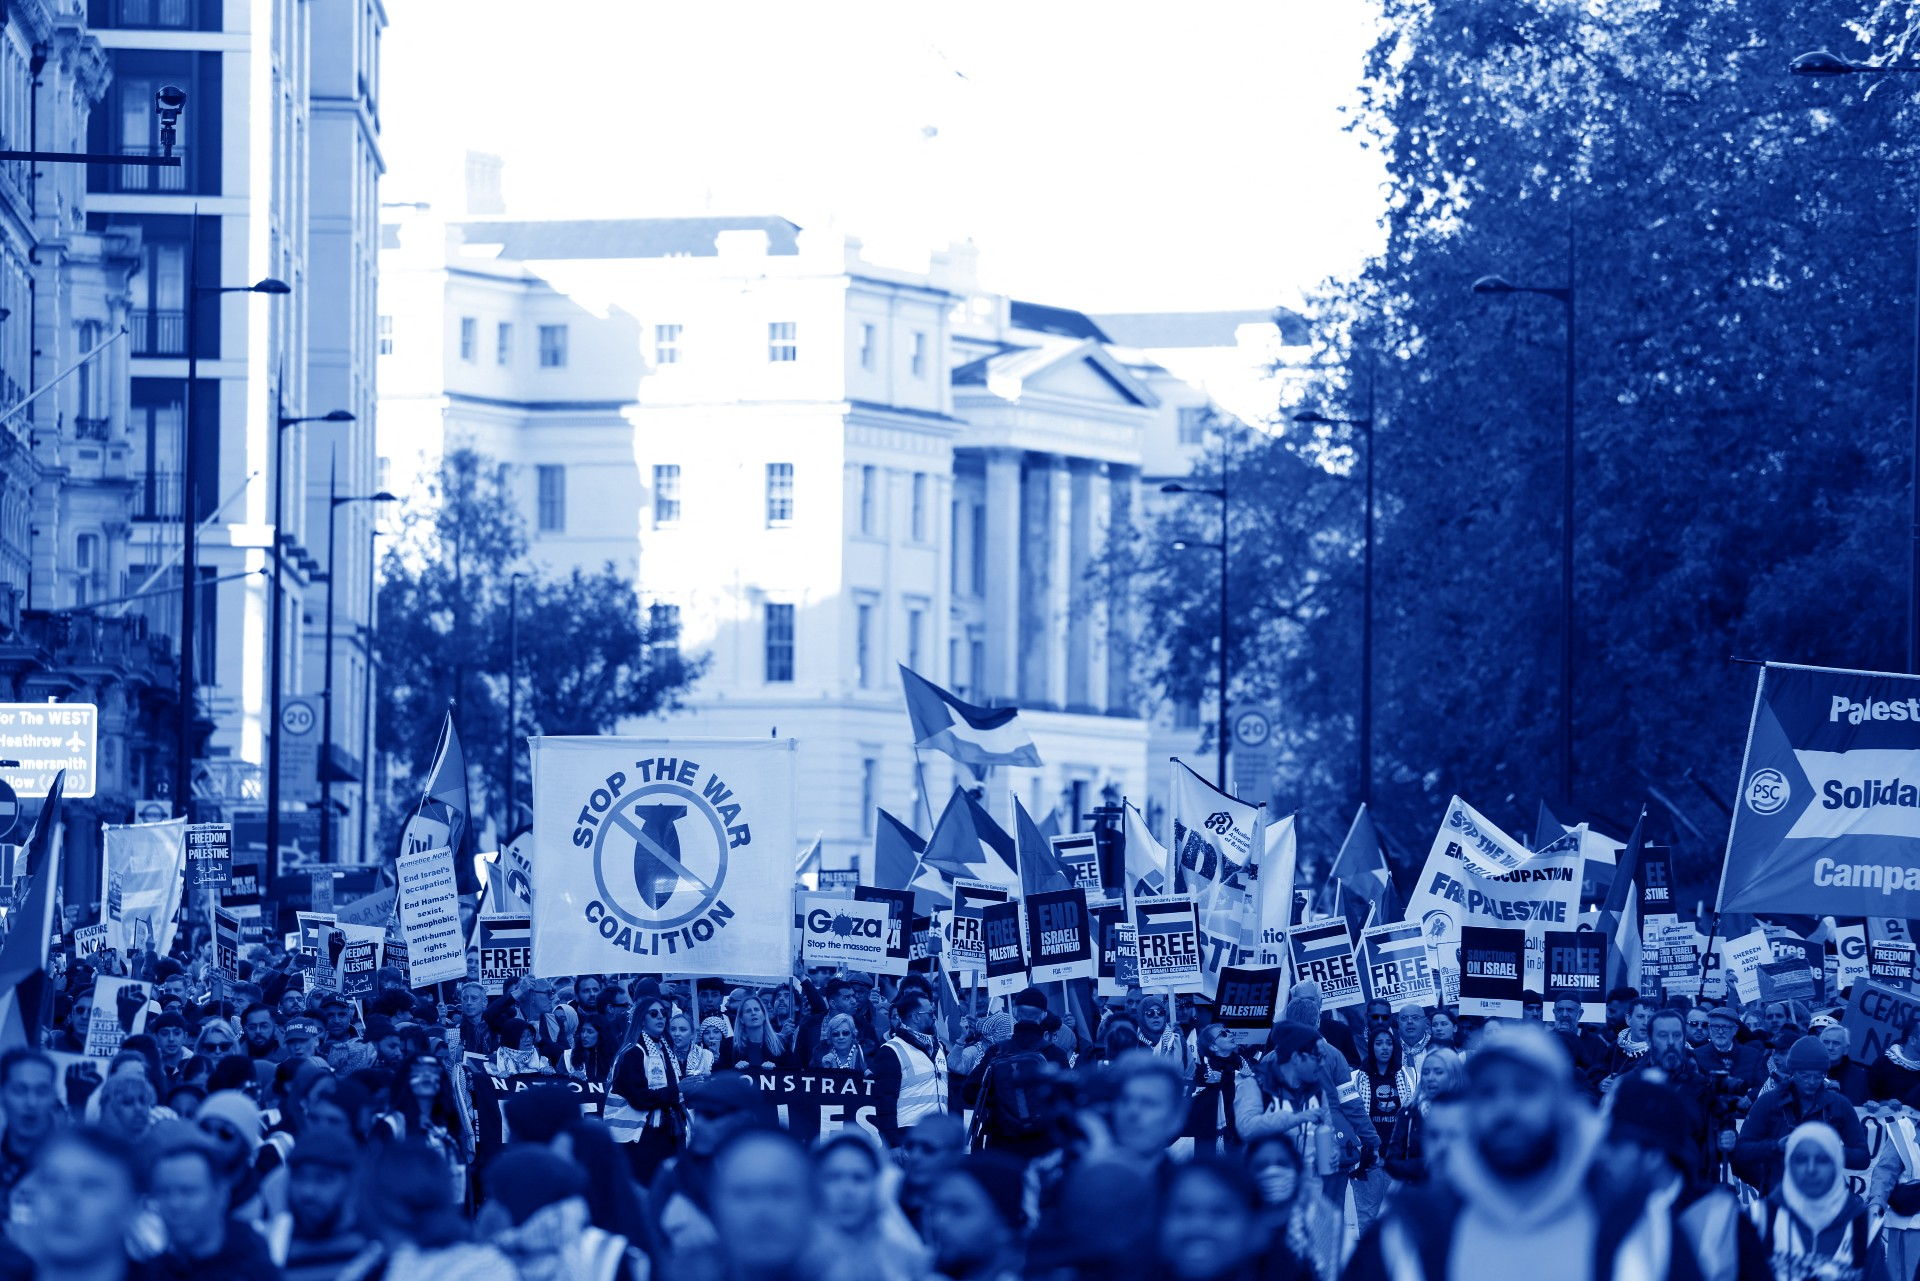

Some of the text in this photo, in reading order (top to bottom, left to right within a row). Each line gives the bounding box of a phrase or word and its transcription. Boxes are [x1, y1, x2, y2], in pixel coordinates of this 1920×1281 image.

[0, 712, 91, 725] or The WEST
[286, 712, 310, 726] 20
[1242, 722, 1264, 736] 20
[0, 757, 87, 770] mersmith
[39, 774, 86, 791] (A0)
[158, 783, 168, 793] 12
[1752, 784, 1781, 801] PSC
[573, 757, 752, 849] STOP THE WAR
[189, 832, 227, 844] FREEDOM
[188, 847, 230, 860] PALESTINE
[1476, 834, 1505, 860] THE
[404, 866, 450, 883] End Israel's
[1075, 862, 1098, 880] EE
[1644, 861, 1667, 886] EE
[1076, 879, 1099, 889] STINE
[1429, 872, 1467, 908] FR
[1645, 887, 1669, 900] STINE
[404, 893, 455, 910] End Hamas's
[417, 907, 444, 918] sexist,
[1038, 901, 1079, 932] END
[406, 915, 457, 932] homophobic,
[585, 899, 736, 956] COALITION
[75, 924, 108, 940] CEASEFIRE
[412, 929, 456, 944] anti-human
[987, 918, 1017, 947] FREE
[1040, 927, 1079, 946] ISRAELI
[386, 945, 408, 957] FREEDO
[424, 942, 447, 953] rights
[807, 940, 882, 953] Stop the massacre
[952, 939, 985, 951] PALES
[1041, 941, 1081, 956] APARTHEID
[1138, 932, 1196, 958] FREE
[1671, 946, 1693, 955] ISRAELI
[1771, 941, 1806, 959] Free
[217, 946, 238, 971] REE
[411, 949, 462, 967] dictatorship!
[988, 945, 1019, 962] PALESTINE
[1467, 949, 1517, 963] SANCTIONS
[1551, 946, 1600, 974] FREE
[1660, 955, 1674, 964] TATE
[1675, 954, 1697, 963] TERROR
[1733, 946, 1762, 960] SHEREEN
[1741, 955, 1759, 965] ABOU
[1874, 949, 1911, 962] FREEDOM
[344, 960, 374, 973] ALESTINE
[1141, 954, 1197, 968] PALESTINE
[1296, 954, 1356, 982] FREE
[1467, 961, 1518, 976] ON ISRAEL
[481, 968, 530, 978] PALESTIN
[1370, 956, 1431, 987] FREE
[1845, 966, 1864, 974] Stop
[1872, 964, 1911, 978] PALESTINE
[1320, 976, 1358, 992] ESTINE
[1444, 974, 1460, 983] EXIS
[1550, 974, 1600, 988] PALESTINE
[1222, 981, 1272, 1005] FREE
[1374, 977, 1432, 997] PALESTINE
[1219, 1005, 1269, 1016] PALESTINE
